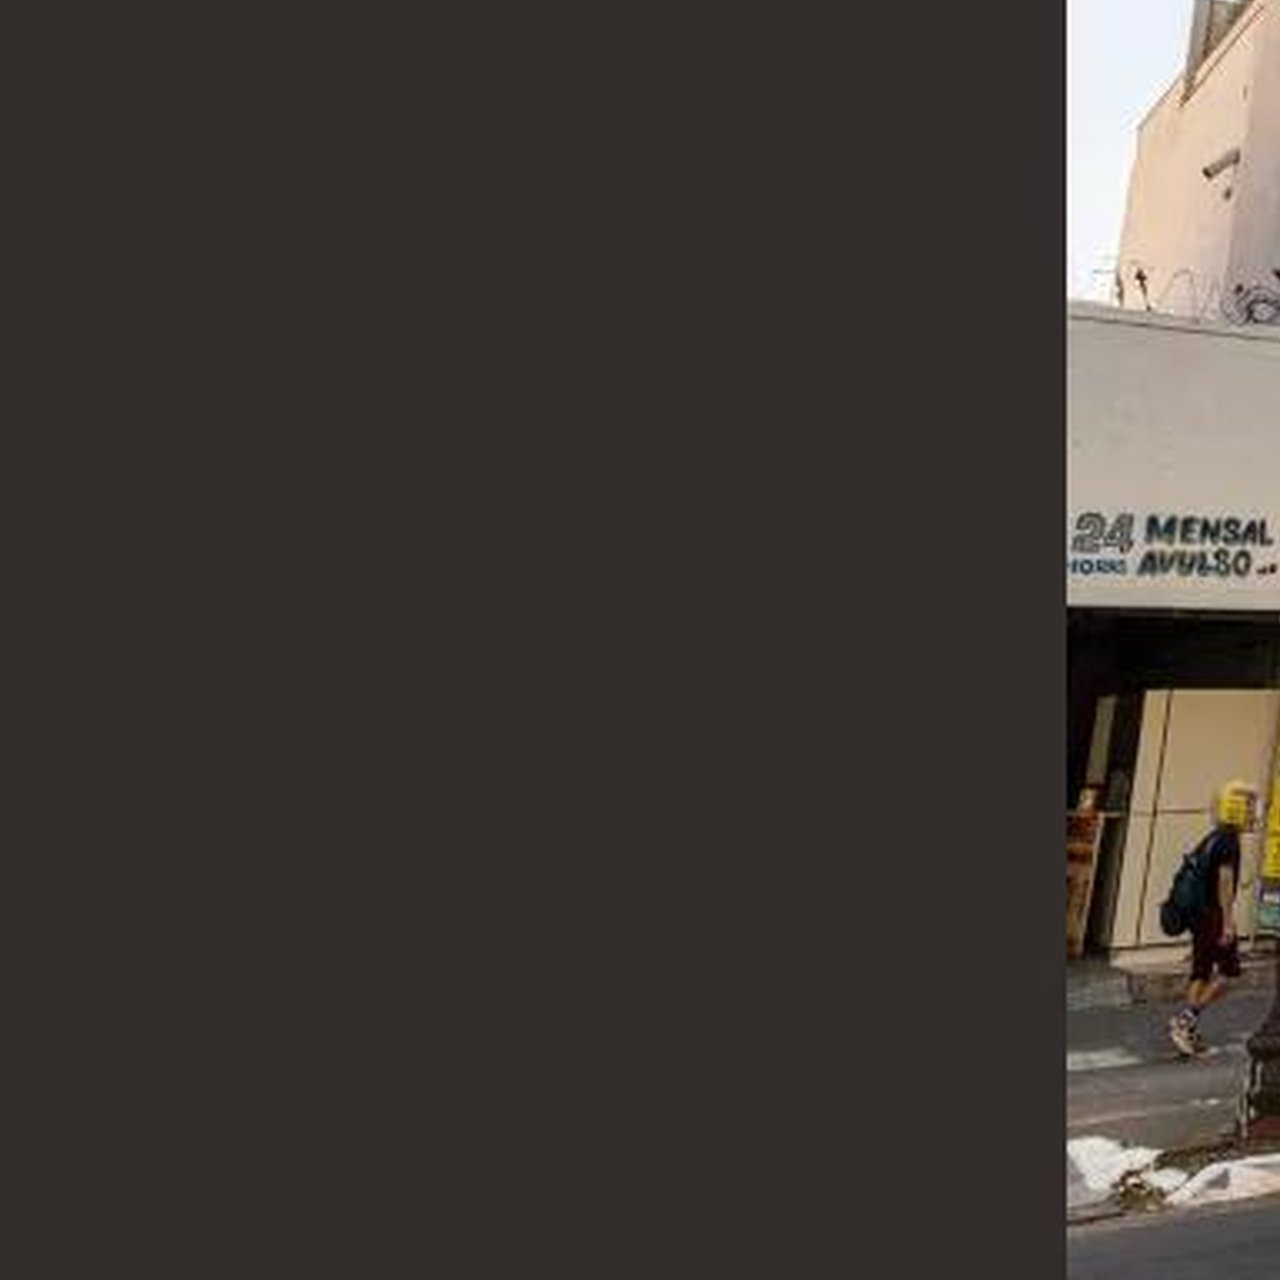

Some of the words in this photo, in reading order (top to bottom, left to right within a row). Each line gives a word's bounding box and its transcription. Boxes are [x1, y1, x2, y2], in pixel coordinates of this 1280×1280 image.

[1071, 511, 1134, 554] 24
[1144, 513, 1275, 546] MENSAL
[1137, 546, 1252, 577] AVULSO
